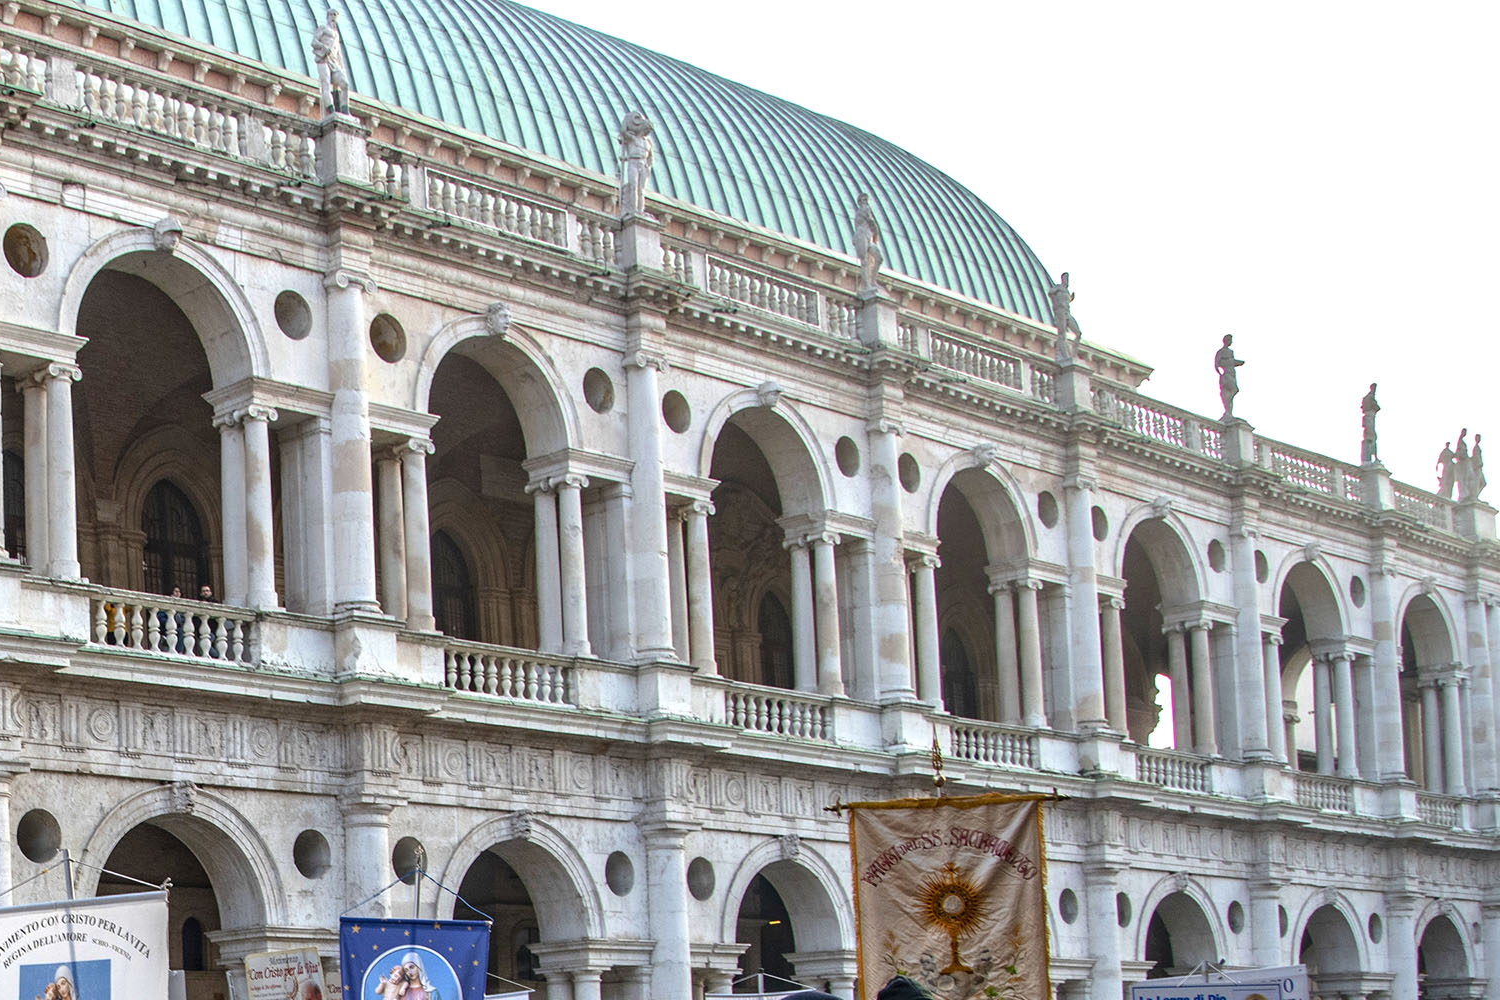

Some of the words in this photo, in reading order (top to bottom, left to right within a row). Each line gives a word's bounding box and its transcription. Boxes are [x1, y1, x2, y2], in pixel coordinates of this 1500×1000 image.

[41, 915, 60, 929] CON
[61, 913, 96, 926] CRISTO
[98, 918, 117, 935] PER
[3, 944, 32, 969] REGINA
[33, 932, 88, 949] DELL'AMORE
[264, 966, 282, 978] Cristo
